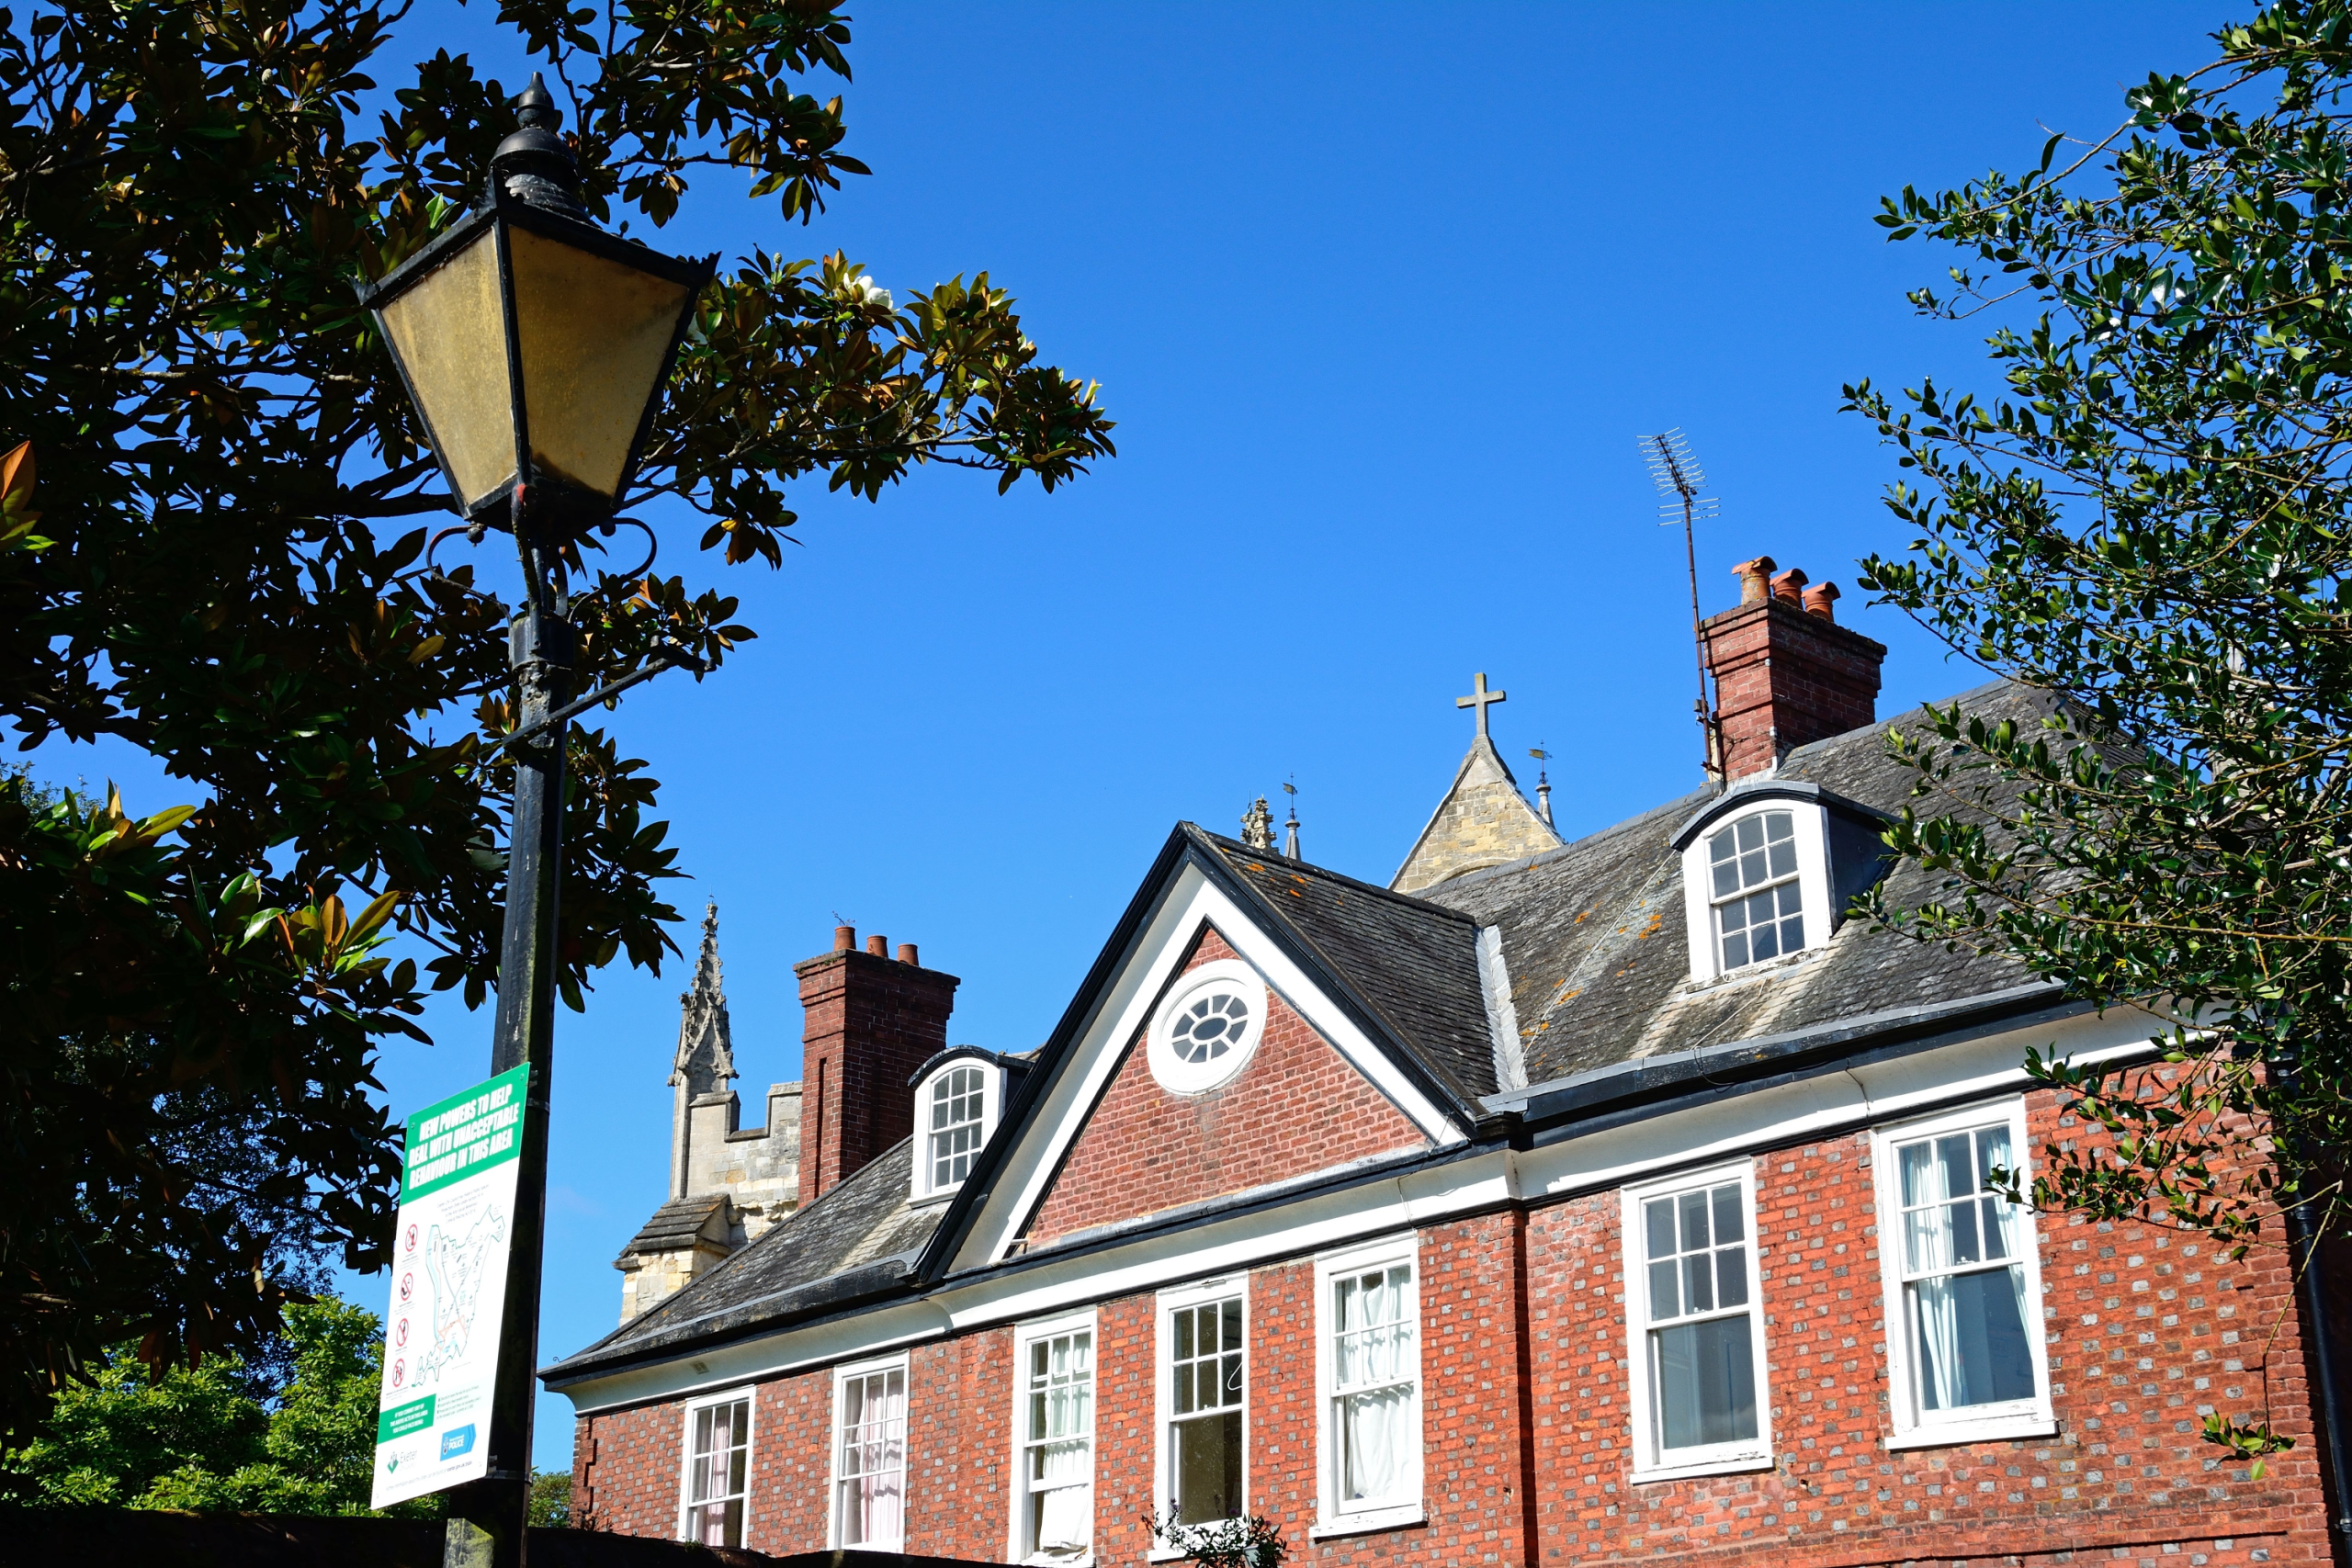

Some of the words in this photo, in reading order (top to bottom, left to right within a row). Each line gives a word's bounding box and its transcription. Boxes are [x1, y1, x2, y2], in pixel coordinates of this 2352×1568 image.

[408, 1143, 428, 1168] DEAL
[429, 1132, 453, 1159] WITH
[453, 1102, 519, 1148] UNACCEPTABLE
[419, 1116, 439, 1142] NEW
[439, 1100, 476, 1133] POWERS
[478, 1094, 490, 1116] TO
[490, 1084, 513, 1111] HELP
[409, 1152, 457, 1190] BEHAVIOUR
[457, 1147, 468, 1169] IN
[469, 1138, 489, 1165] THIS
[489, 1128, 513, 1156] AREA
[400, 1450, 418, 1464] Exeter
[448, 1438, 464, 1450] POLICE
